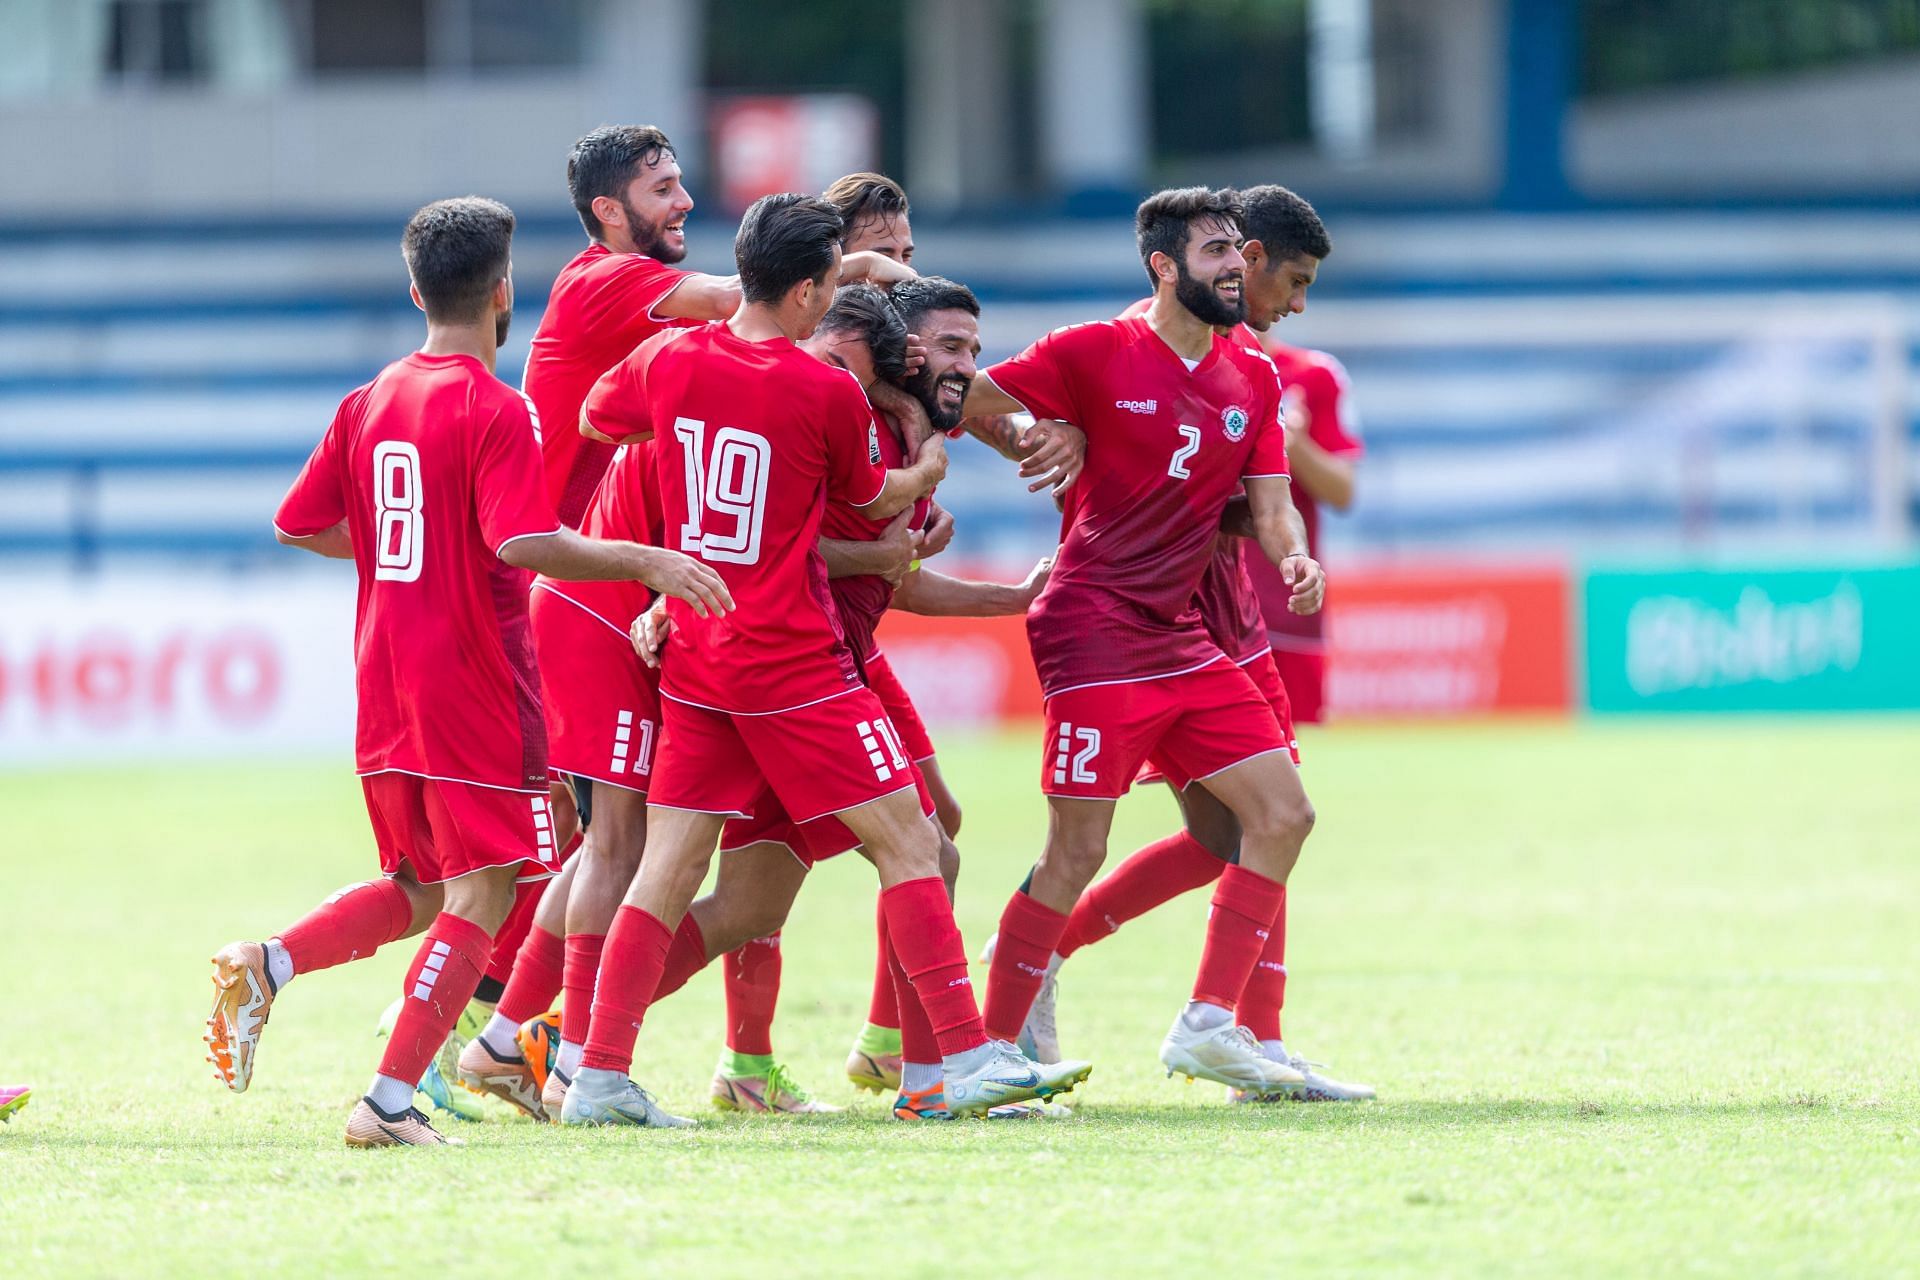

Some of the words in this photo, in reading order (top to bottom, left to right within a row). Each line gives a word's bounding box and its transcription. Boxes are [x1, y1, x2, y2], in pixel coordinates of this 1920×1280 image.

[1115, 399, 1157, 411] capelli
[1168, 423, 1201, 479] 2
[373, 440, 425, 582] 8
[674, 416, 771, 565] 19
[633, 719, 660, 776] 1
[1072, 727, 1101, 783] 2
